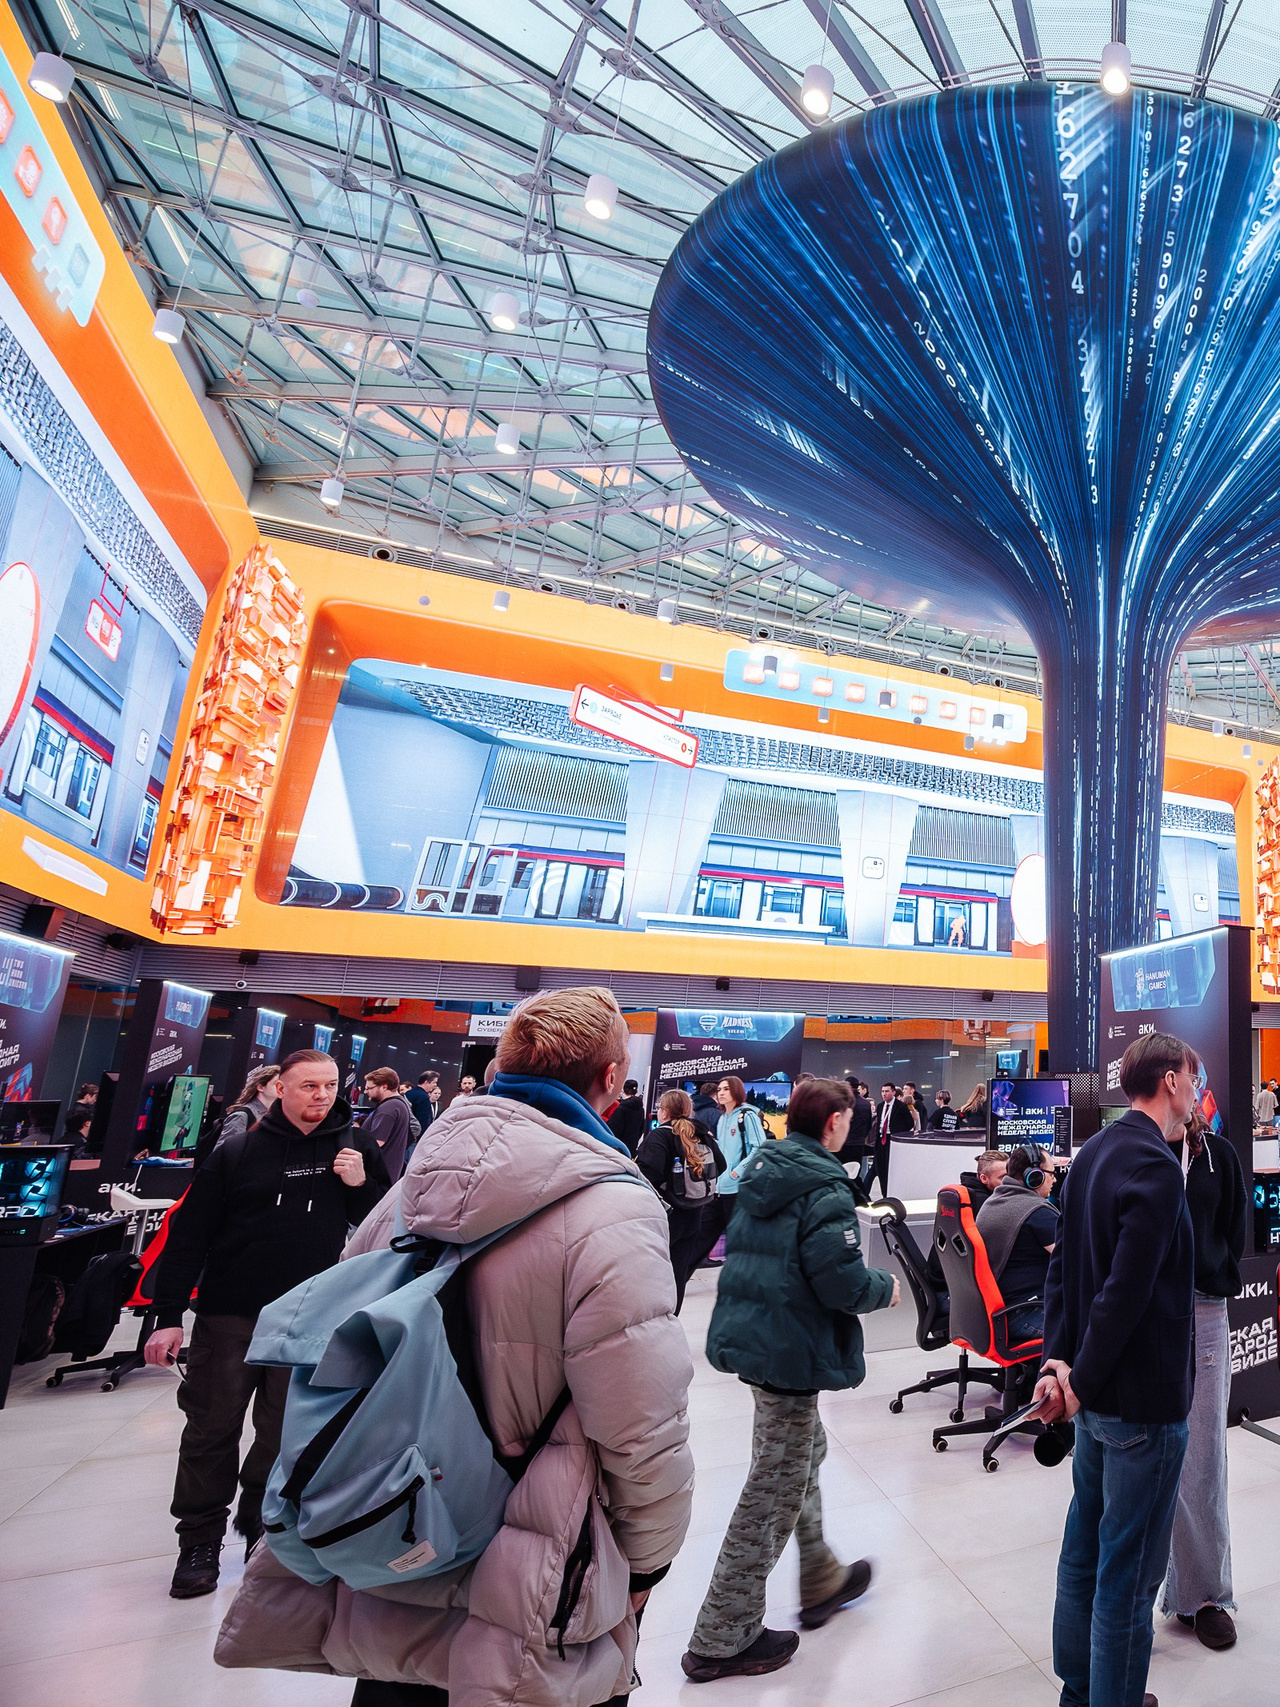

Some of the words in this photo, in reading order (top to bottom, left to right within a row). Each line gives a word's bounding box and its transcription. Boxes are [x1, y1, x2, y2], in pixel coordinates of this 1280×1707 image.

[1145, 969, 1171, 981] HANUMAN
[1148, 980, 1167, 991] GAMES
[721, 1015, 754, 1030] MADNESS
[1138, 1023, 1157, 1035] аки.
[702, 1044, 723, 1052] аки.
[660, 1057, 745, 1075] МЕЖДУНАРОДНАЯ
[661, 1055, 722, 1070] МОСКОВСКАЯ
[659, 1070, 697, 1080] НЕДЕЛЯ
[697, 1062, 748, 1076] ВИДЕОИГР
